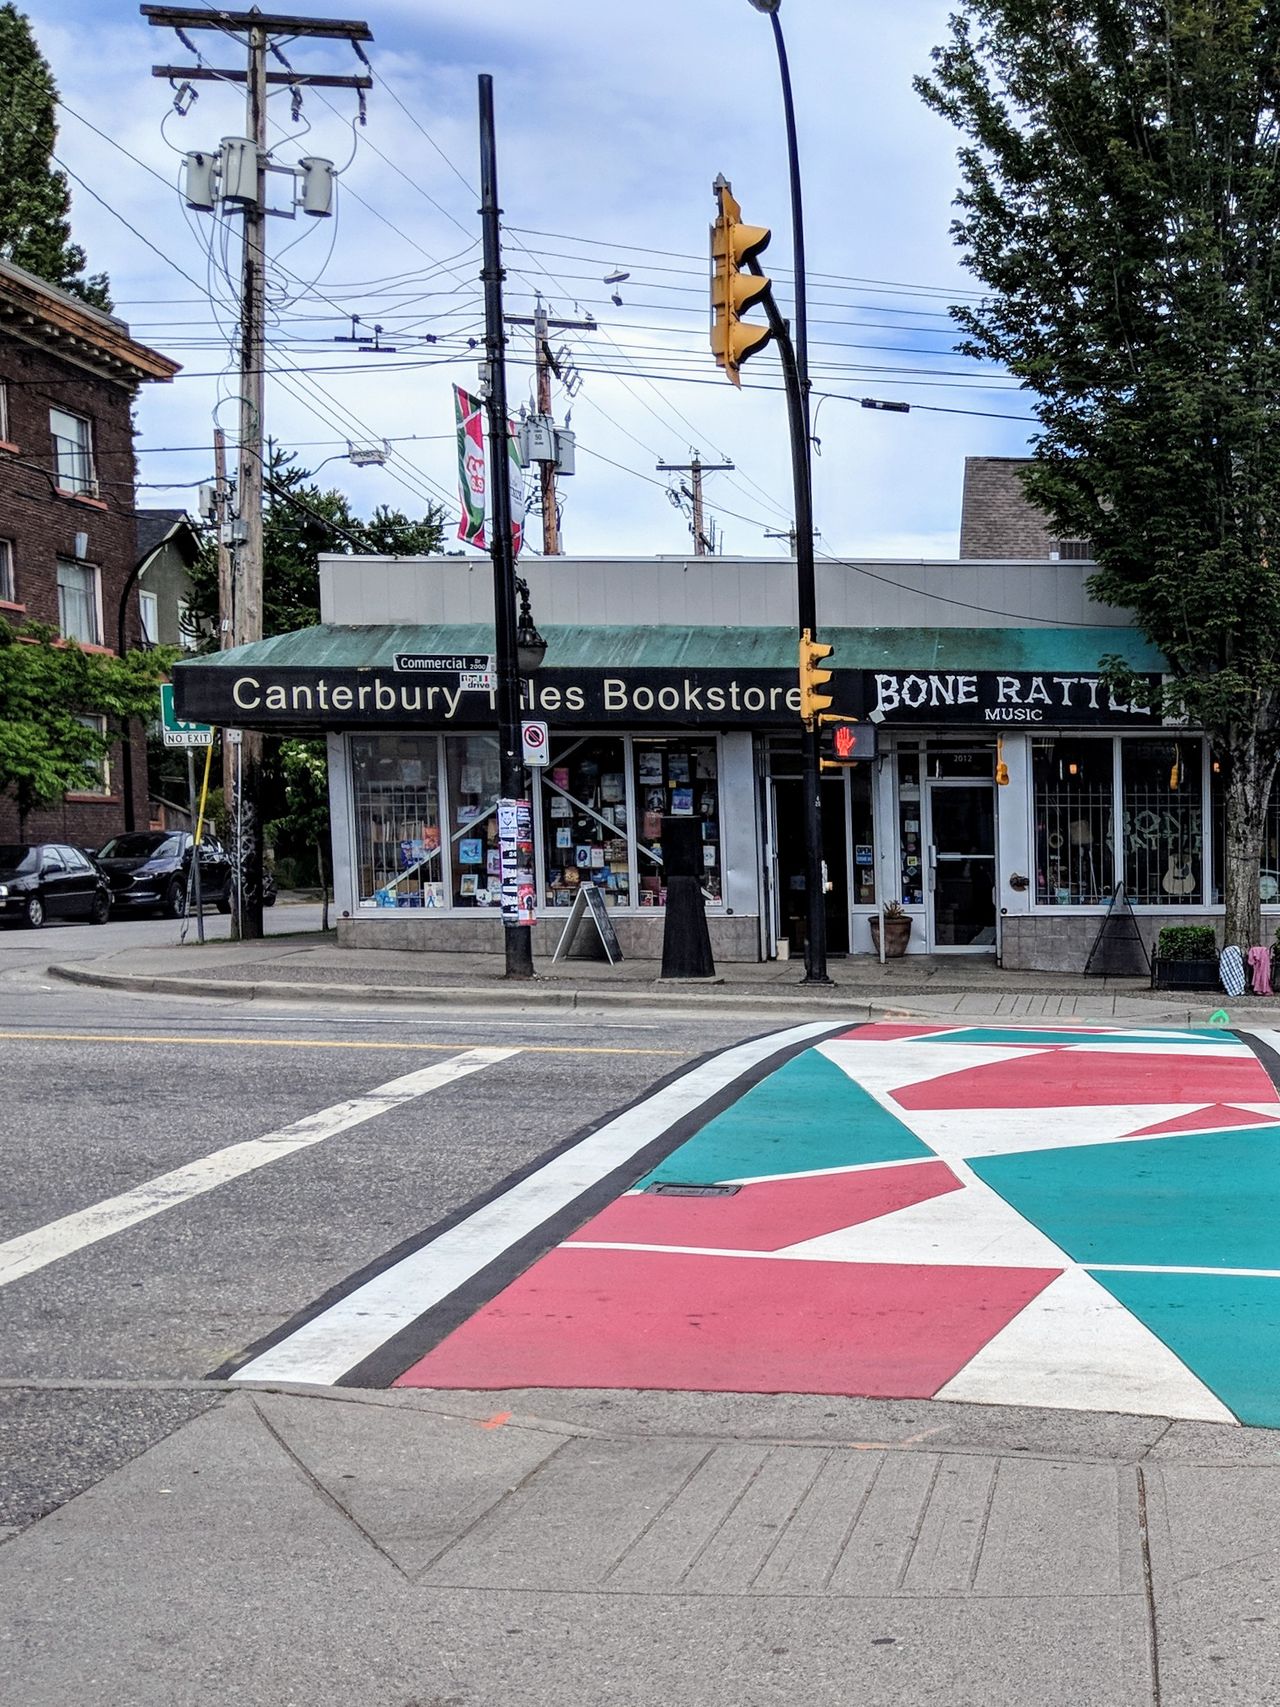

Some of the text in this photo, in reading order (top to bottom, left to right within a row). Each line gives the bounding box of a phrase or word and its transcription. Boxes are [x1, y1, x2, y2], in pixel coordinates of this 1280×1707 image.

[400, 657, 467, 669] Commercial
[467, 681, 491, 689] drive
[232, 677, 463, 719] Canterbury
[488, 679, 586, 711] les
[603, 679, 802, 711] Bookstore
[874, 674, 979, 712] BONE
[984, 708, 1044, 721] MUSIC
[167, 734, 209, 743] NO EXIT
[953, 755, 973, 763] 2012
